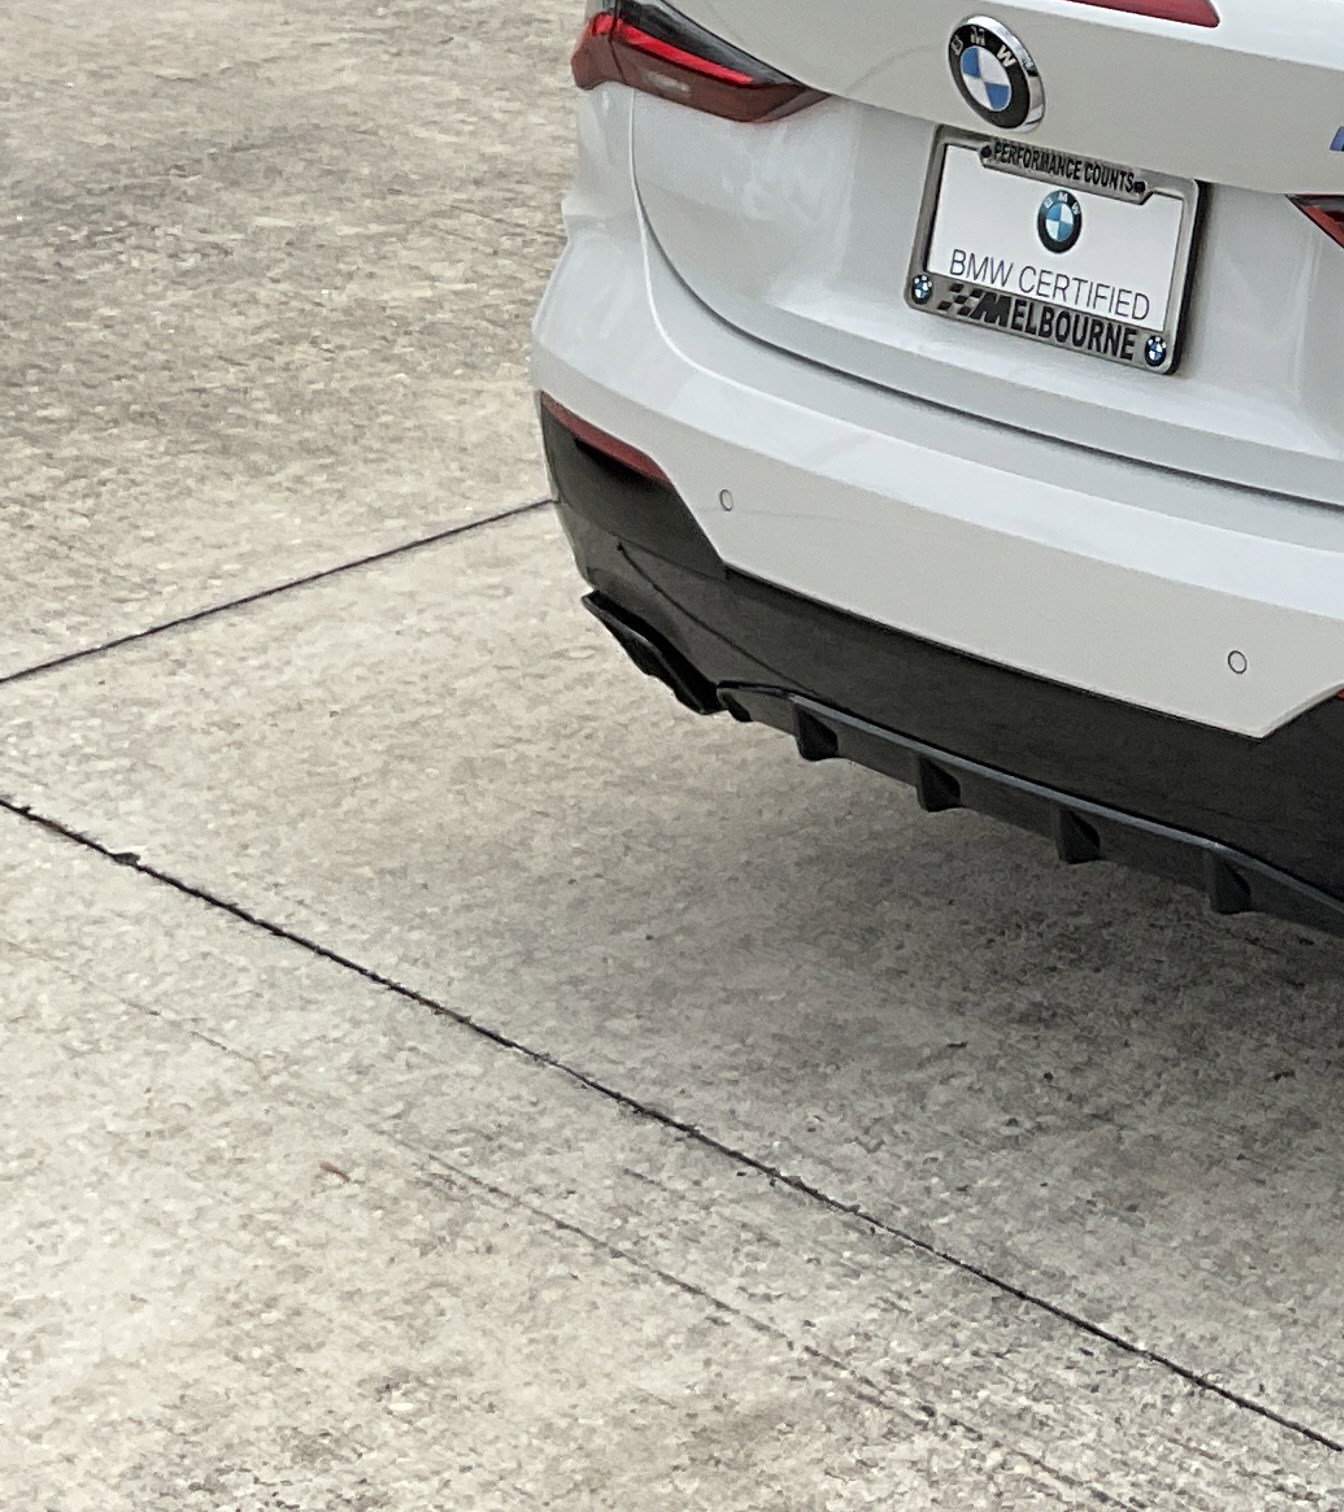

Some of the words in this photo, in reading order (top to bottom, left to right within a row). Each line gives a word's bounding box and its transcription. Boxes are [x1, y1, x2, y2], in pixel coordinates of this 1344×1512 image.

[994, 141, 1081, 180] PERFORMANCE
[1084, 161, 1135, 194] COUNTS
[949, 248, 1014, 289] BMW
[1018, 265, 1150, 321] CERTIFIED
[969, 291, 1137, 362] MELBOURNE
